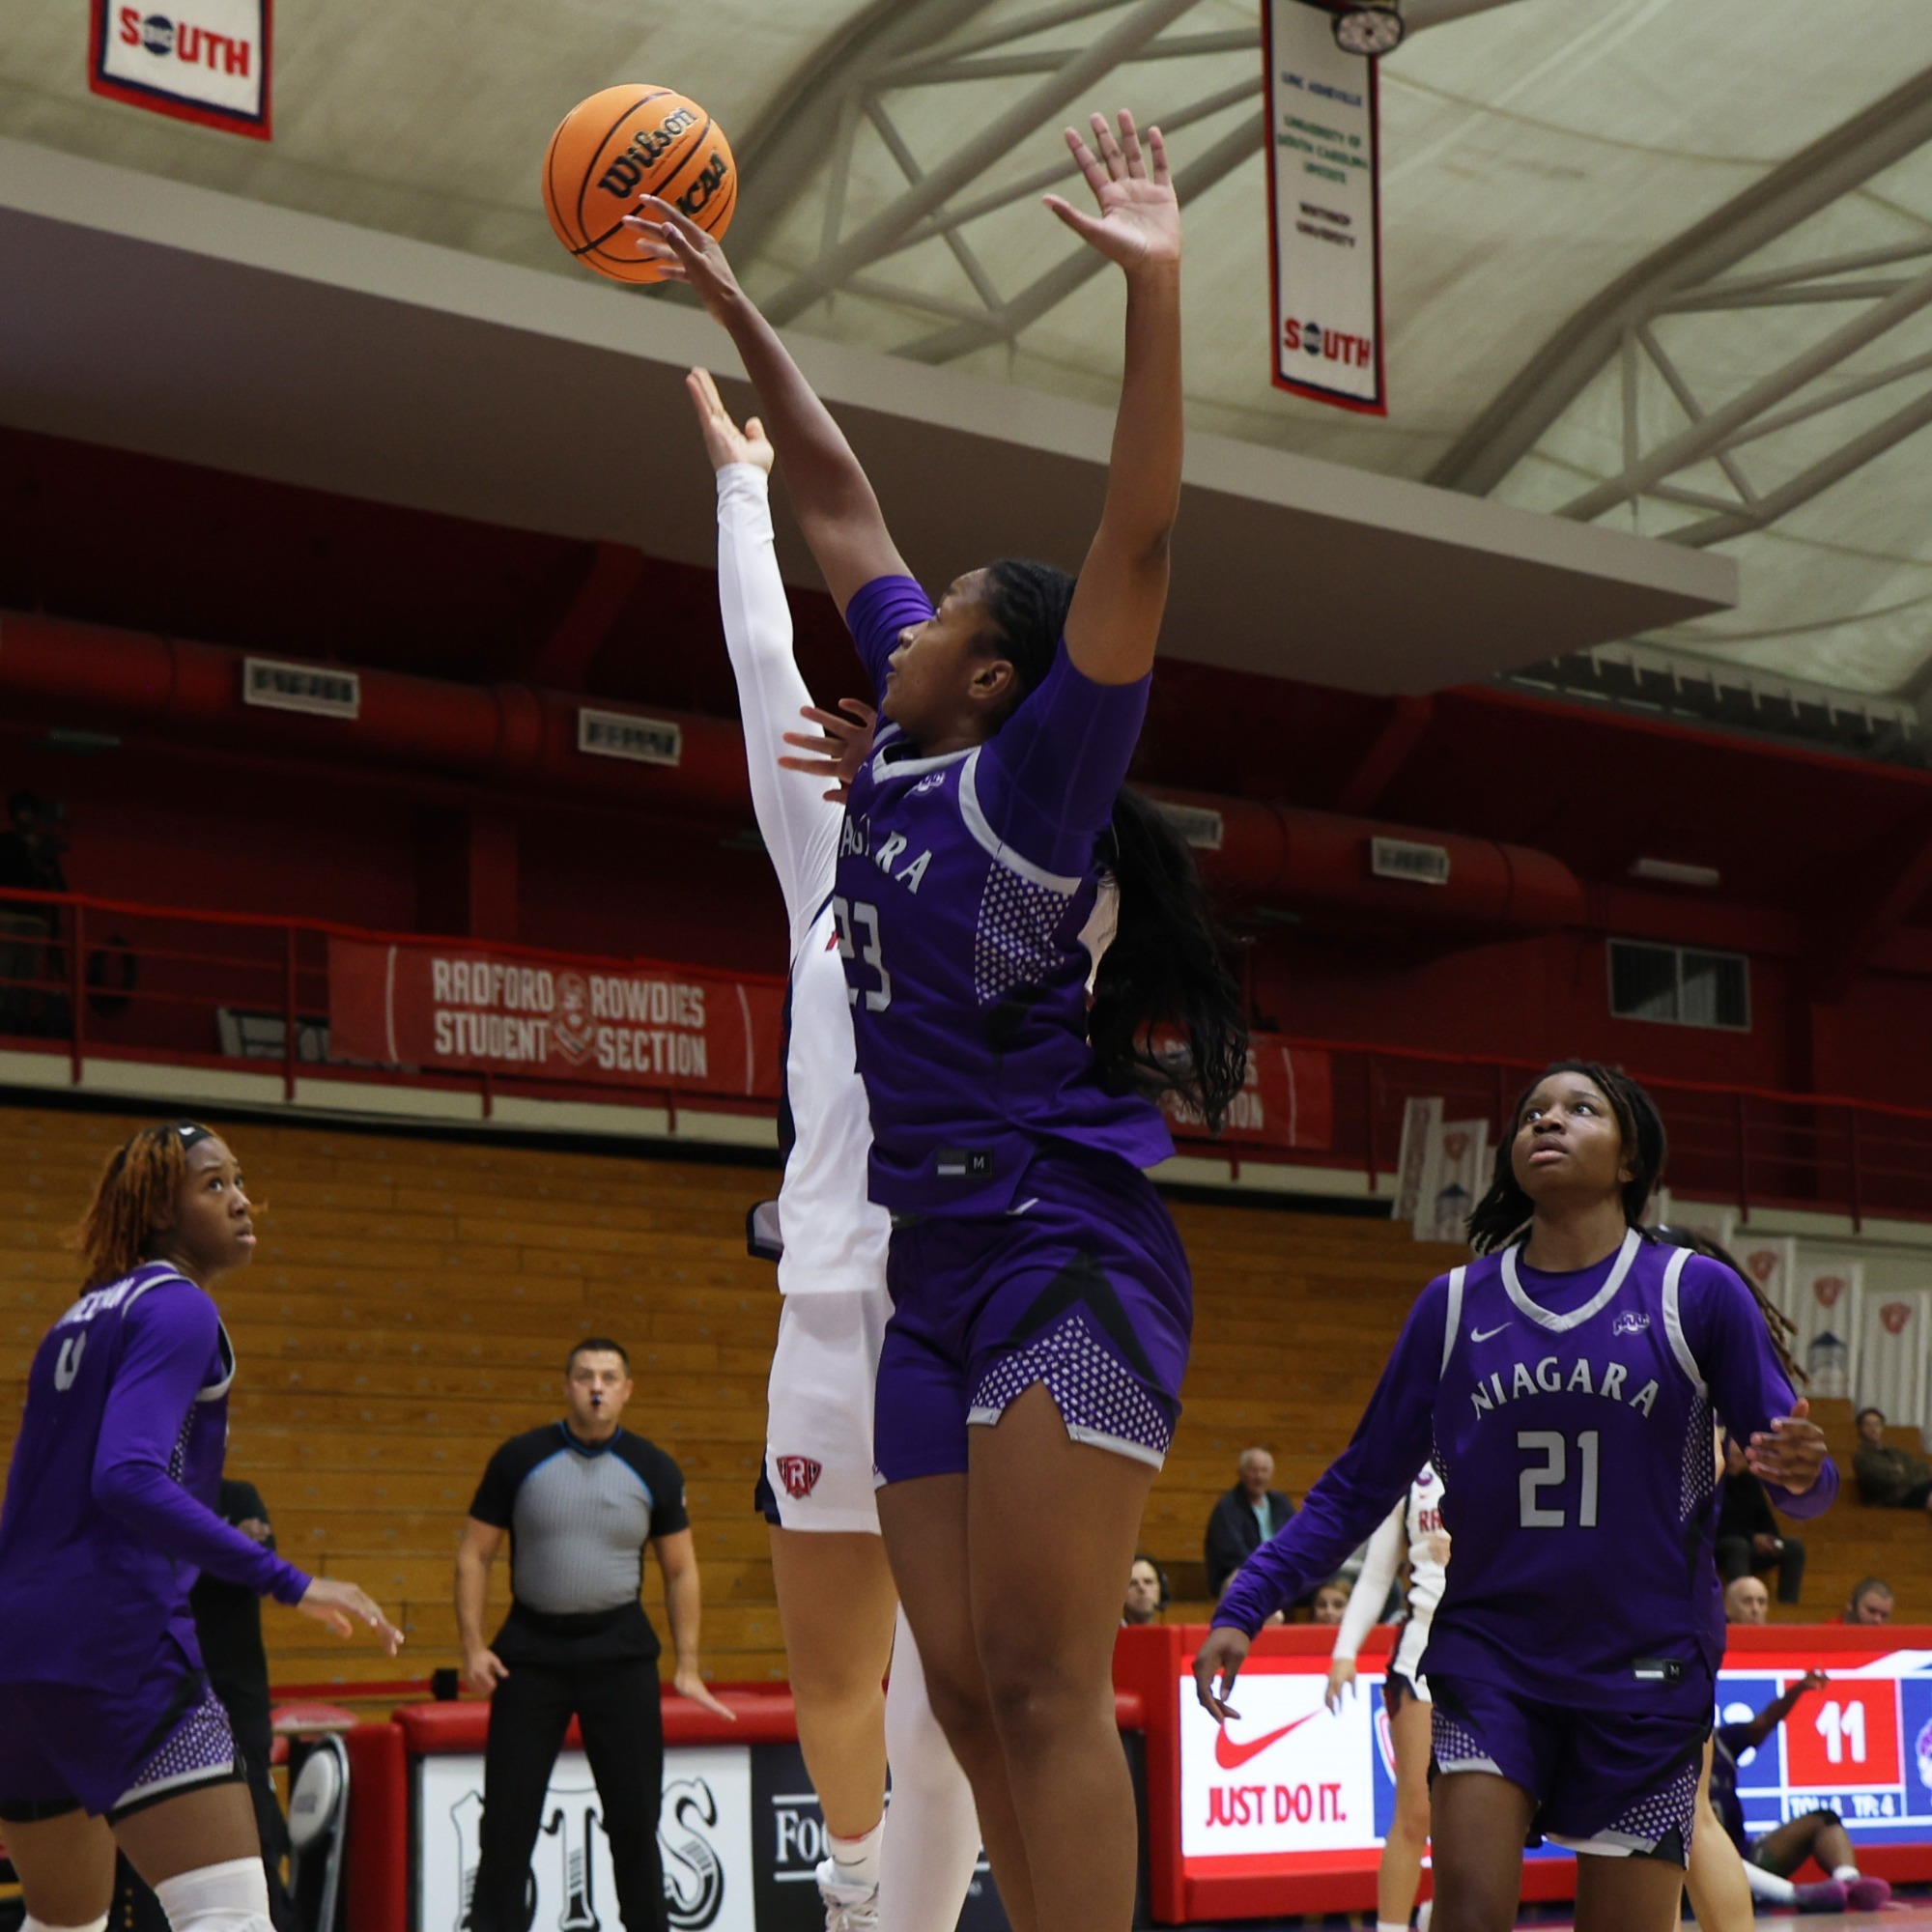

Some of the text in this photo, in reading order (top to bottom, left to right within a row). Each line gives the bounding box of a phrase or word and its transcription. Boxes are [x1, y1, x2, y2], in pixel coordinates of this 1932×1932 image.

[120, 6, 249, 77] SOUTH
[598, 108, 697, 198] Wilson
[1285, 317, 1372, 369] SOUTH
[432, 957, 705, 1029] RADFORD ROWDIES
[435, 1009, 707, 1078] STUDENT SECTION
[973, 1156, 984, 1170] M
[1470, 1356, 1660, 1421] NIAGARA
[1518, 1431, 1599, 1527] 21
[1815, 1700, 1867, 1764] 11
[1207, 1782, 1347, 1827] JUST DO IT.
